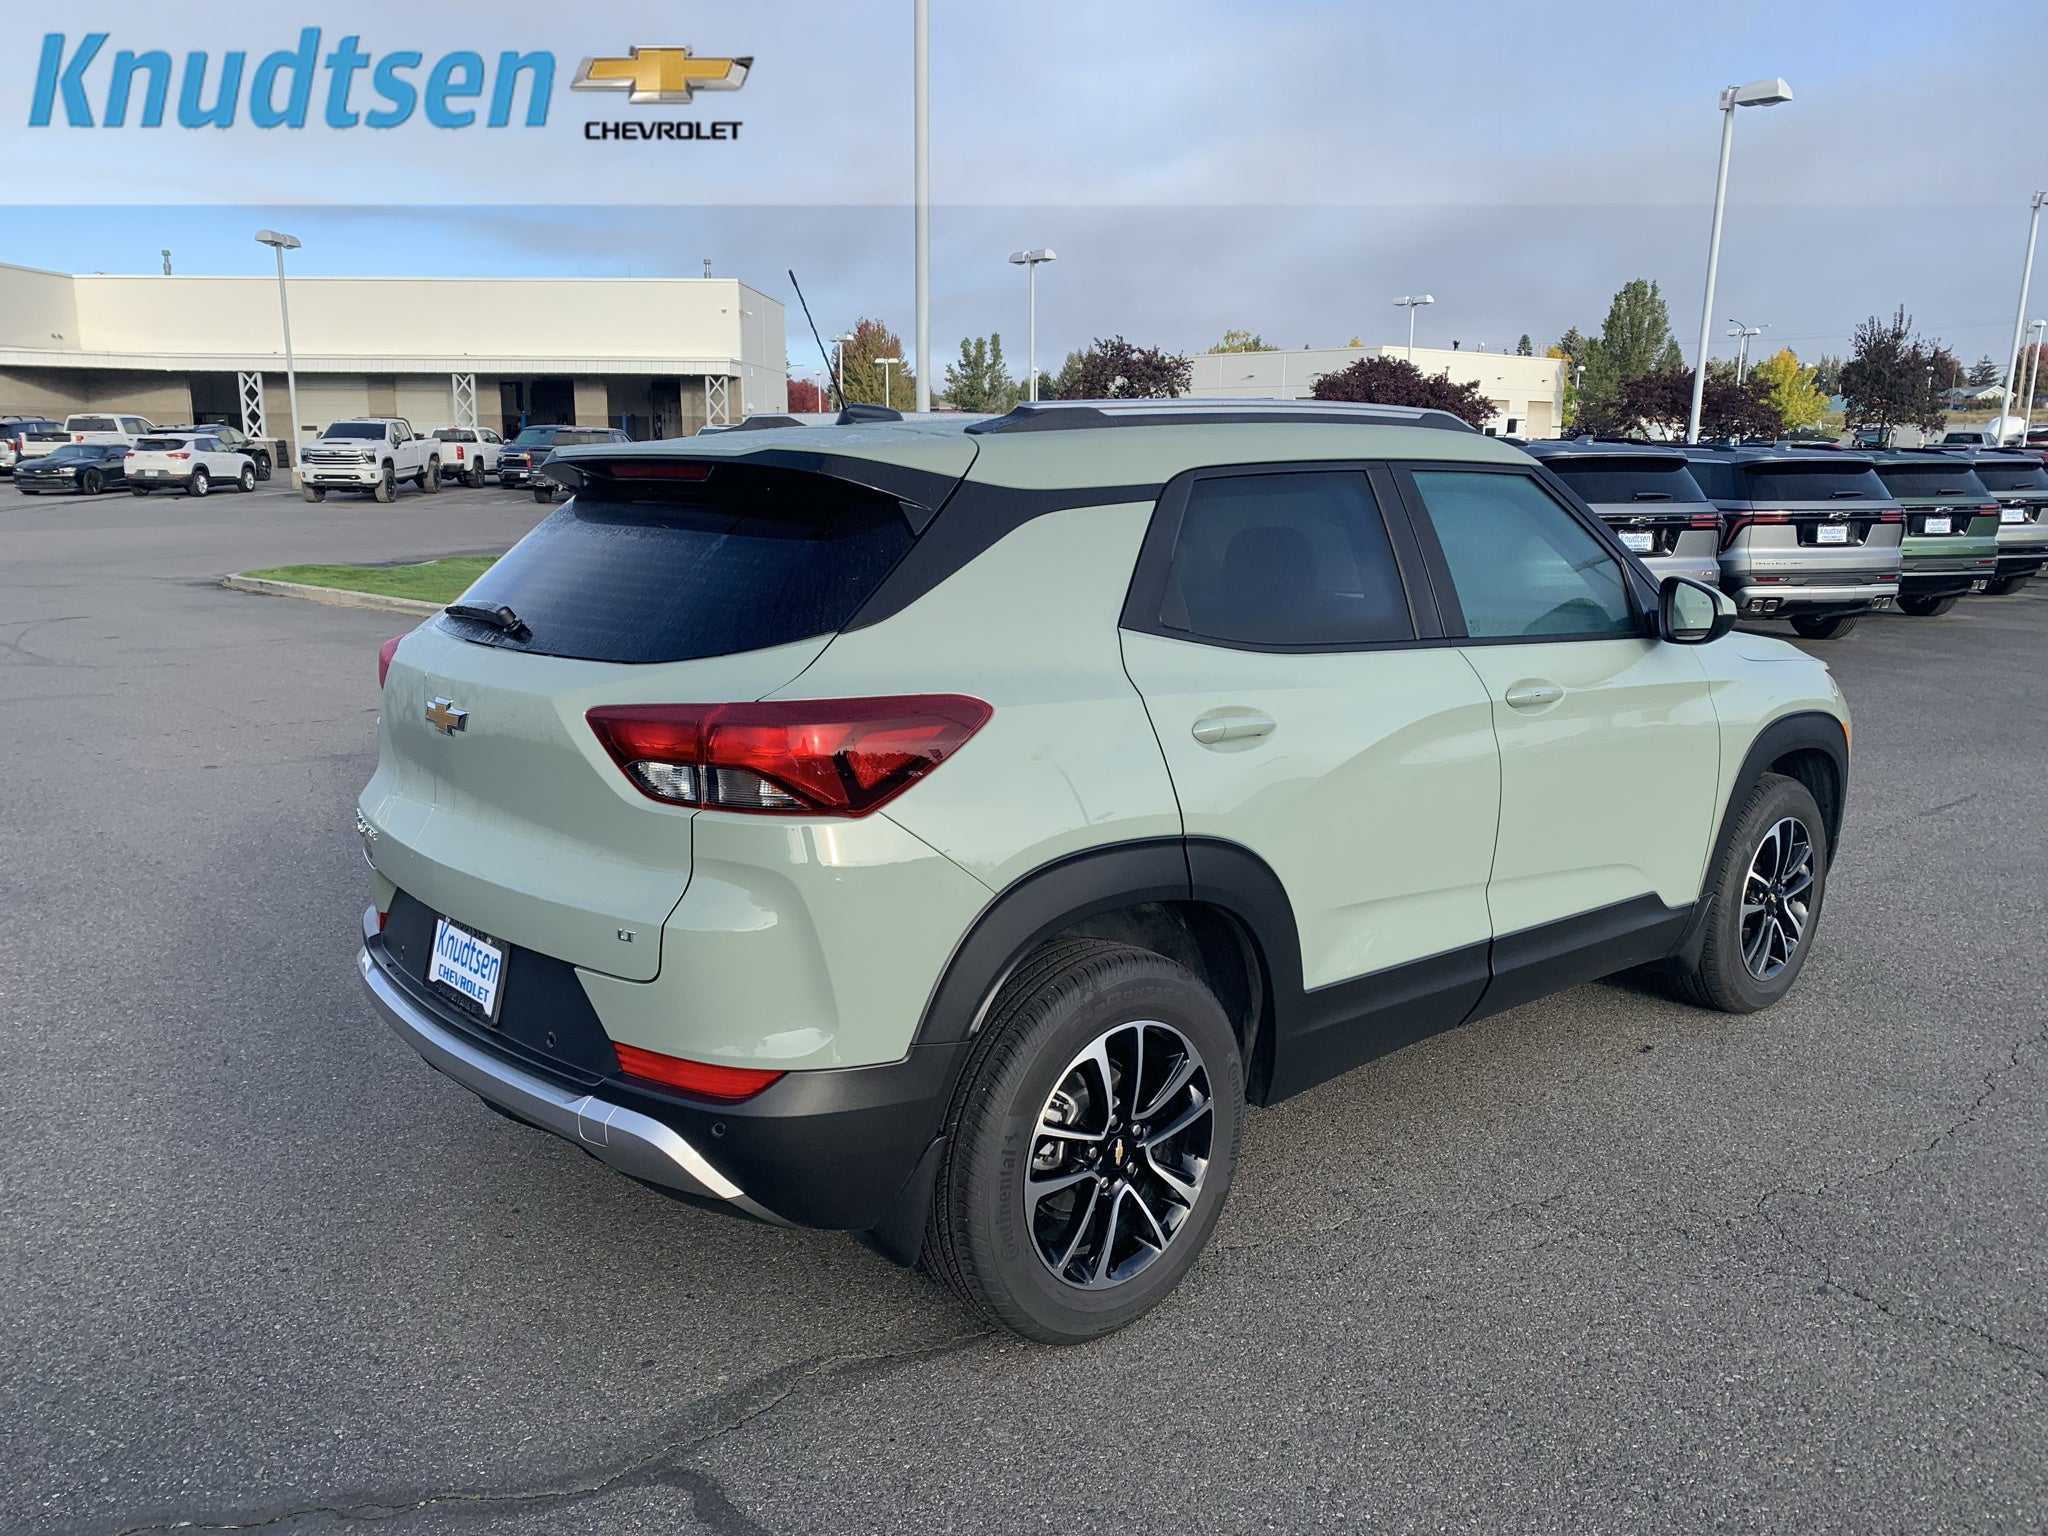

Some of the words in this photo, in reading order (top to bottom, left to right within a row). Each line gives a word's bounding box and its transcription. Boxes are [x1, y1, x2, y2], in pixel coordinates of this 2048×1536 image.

[436, 921, 500, 984] Knudtsen
[617, 928, 637, 942] LT
[438, 963, 490, 1003] CHEVROLET
